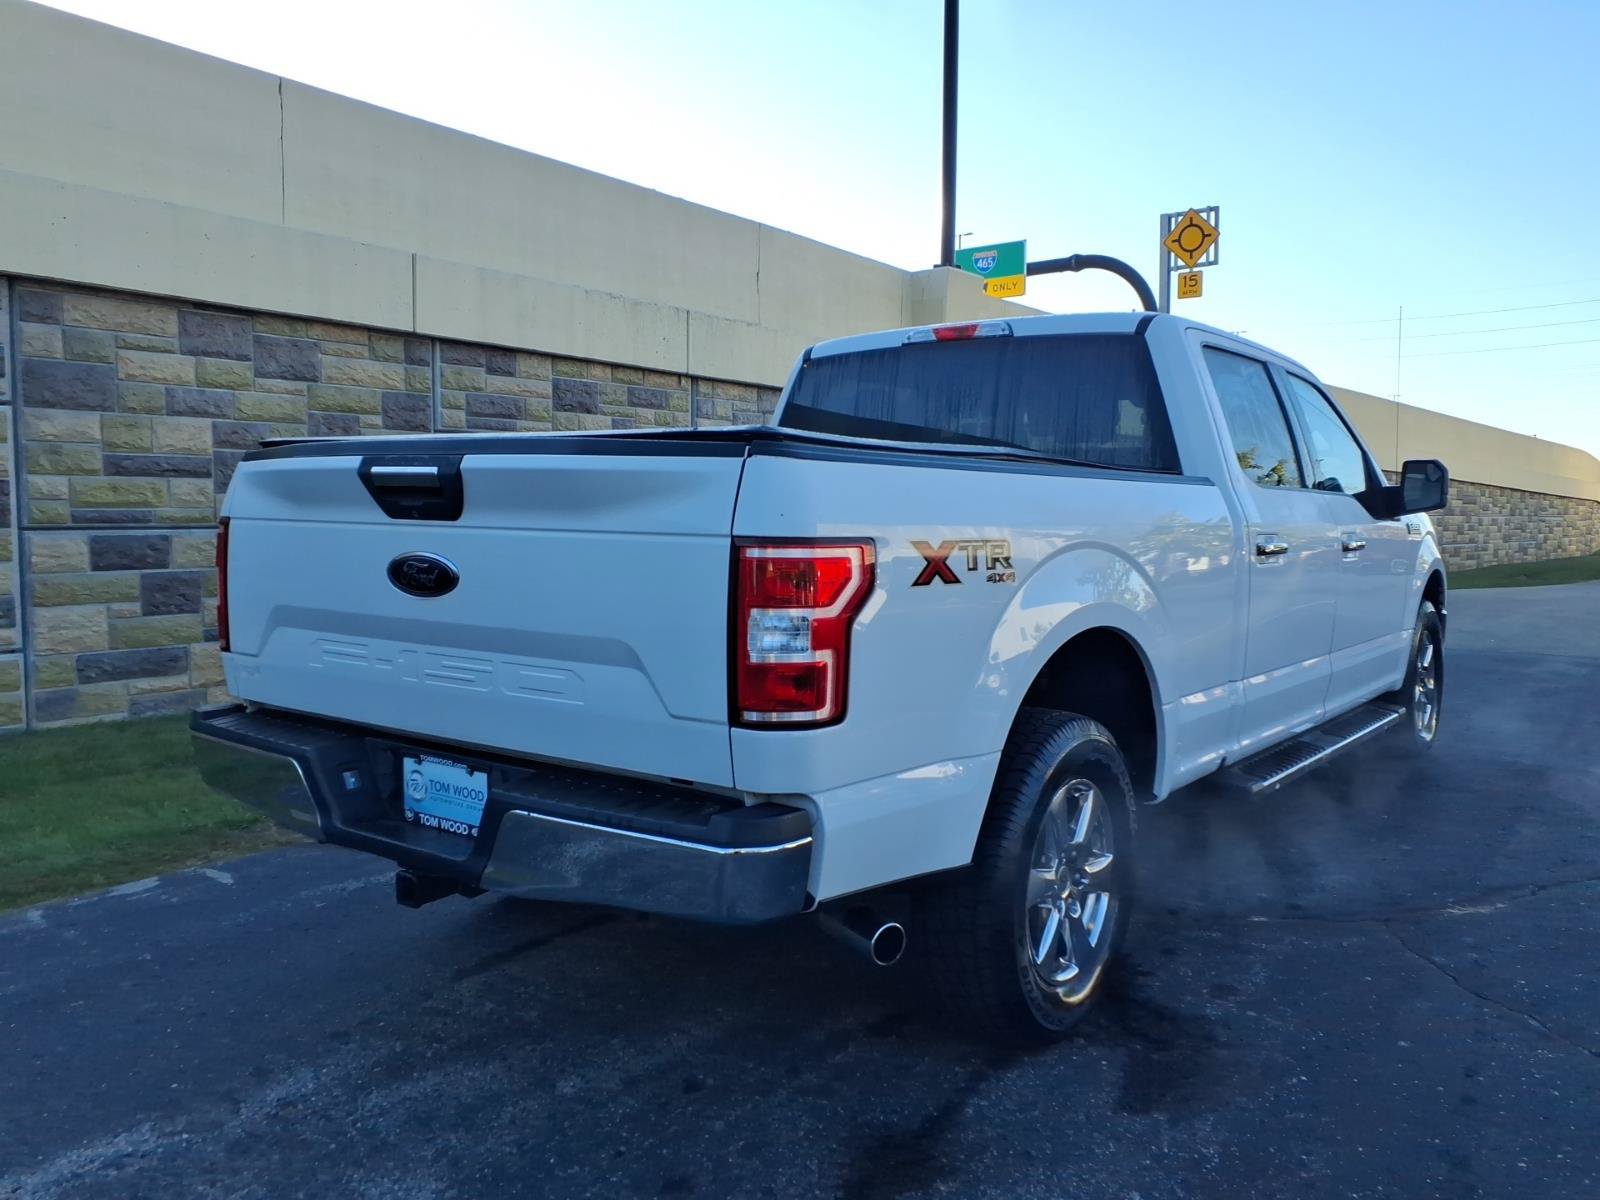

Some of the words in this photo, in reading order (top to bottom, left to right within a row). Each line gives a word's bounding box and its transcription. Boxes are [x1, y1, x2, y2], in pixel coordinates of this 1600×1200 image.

[977, 257, 993, 268] 465
[993, 281, 1017, 292] ONLY
[1182, 275, 1198, 288] 15
[910, 540, 1014, 586] XTR
[402, 561, 438, 587] Ford
[309, 638, 585, 705] F-150
[429, 780, 450, 794] TOM
[453, 785, 484, 801] WOOD
[419, 814, 438, 827] TOM
[440, 819, 468, 834] WOOD
